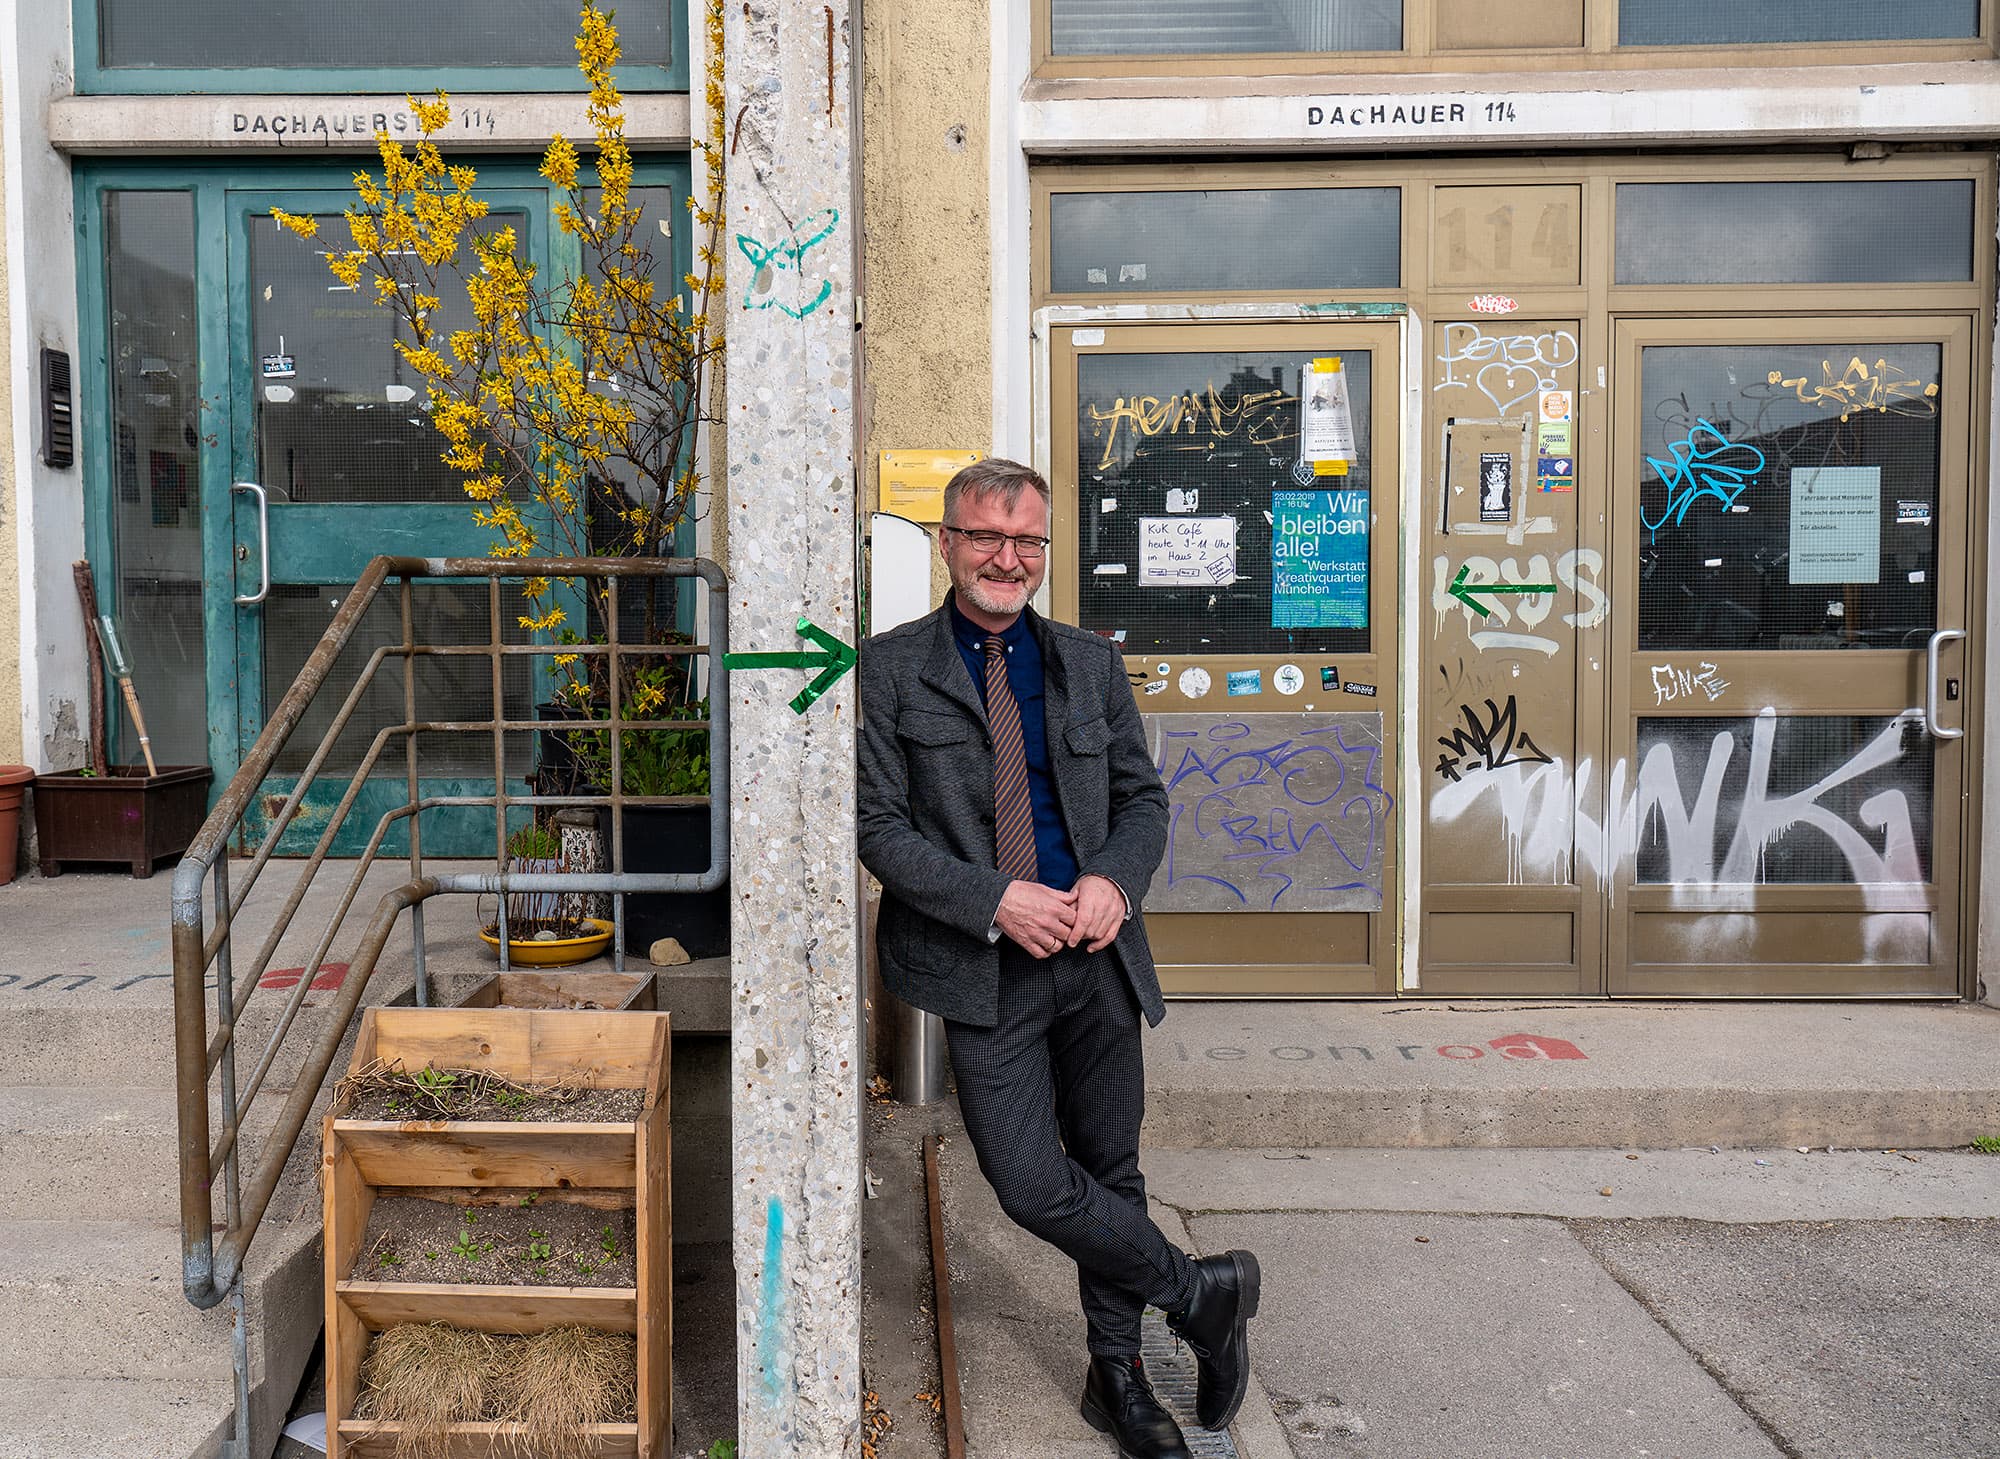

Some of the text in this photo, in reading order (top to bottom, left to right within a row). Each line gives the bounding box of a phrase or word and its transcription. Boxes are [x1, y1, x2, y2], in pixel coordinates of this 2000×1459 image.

[461, 108, 495, 135] 114
[1307, 102, 1517, 126] DACHAUER 114
[1438, 203, 1573, 272] 114
[1327, 492, 1367, 513] Wir
[1148, 522, 1202, 539] KuK Café
[1281, 513, 1365, 535] bleiben
[1148, 539, 1173, 549] heute
[1214, 538, 1230, 548] Uhr
[1275, 535, 1319, 557] alle!
[1168, 551, 1192, 561] Haus
[1199, 551, 1208, 560] 2
[1307, 560, 1366, 572] Werkstatt
[1276, 571, 1366, 585] Kreativquartier
[1274, 583, 1329, 595] München
